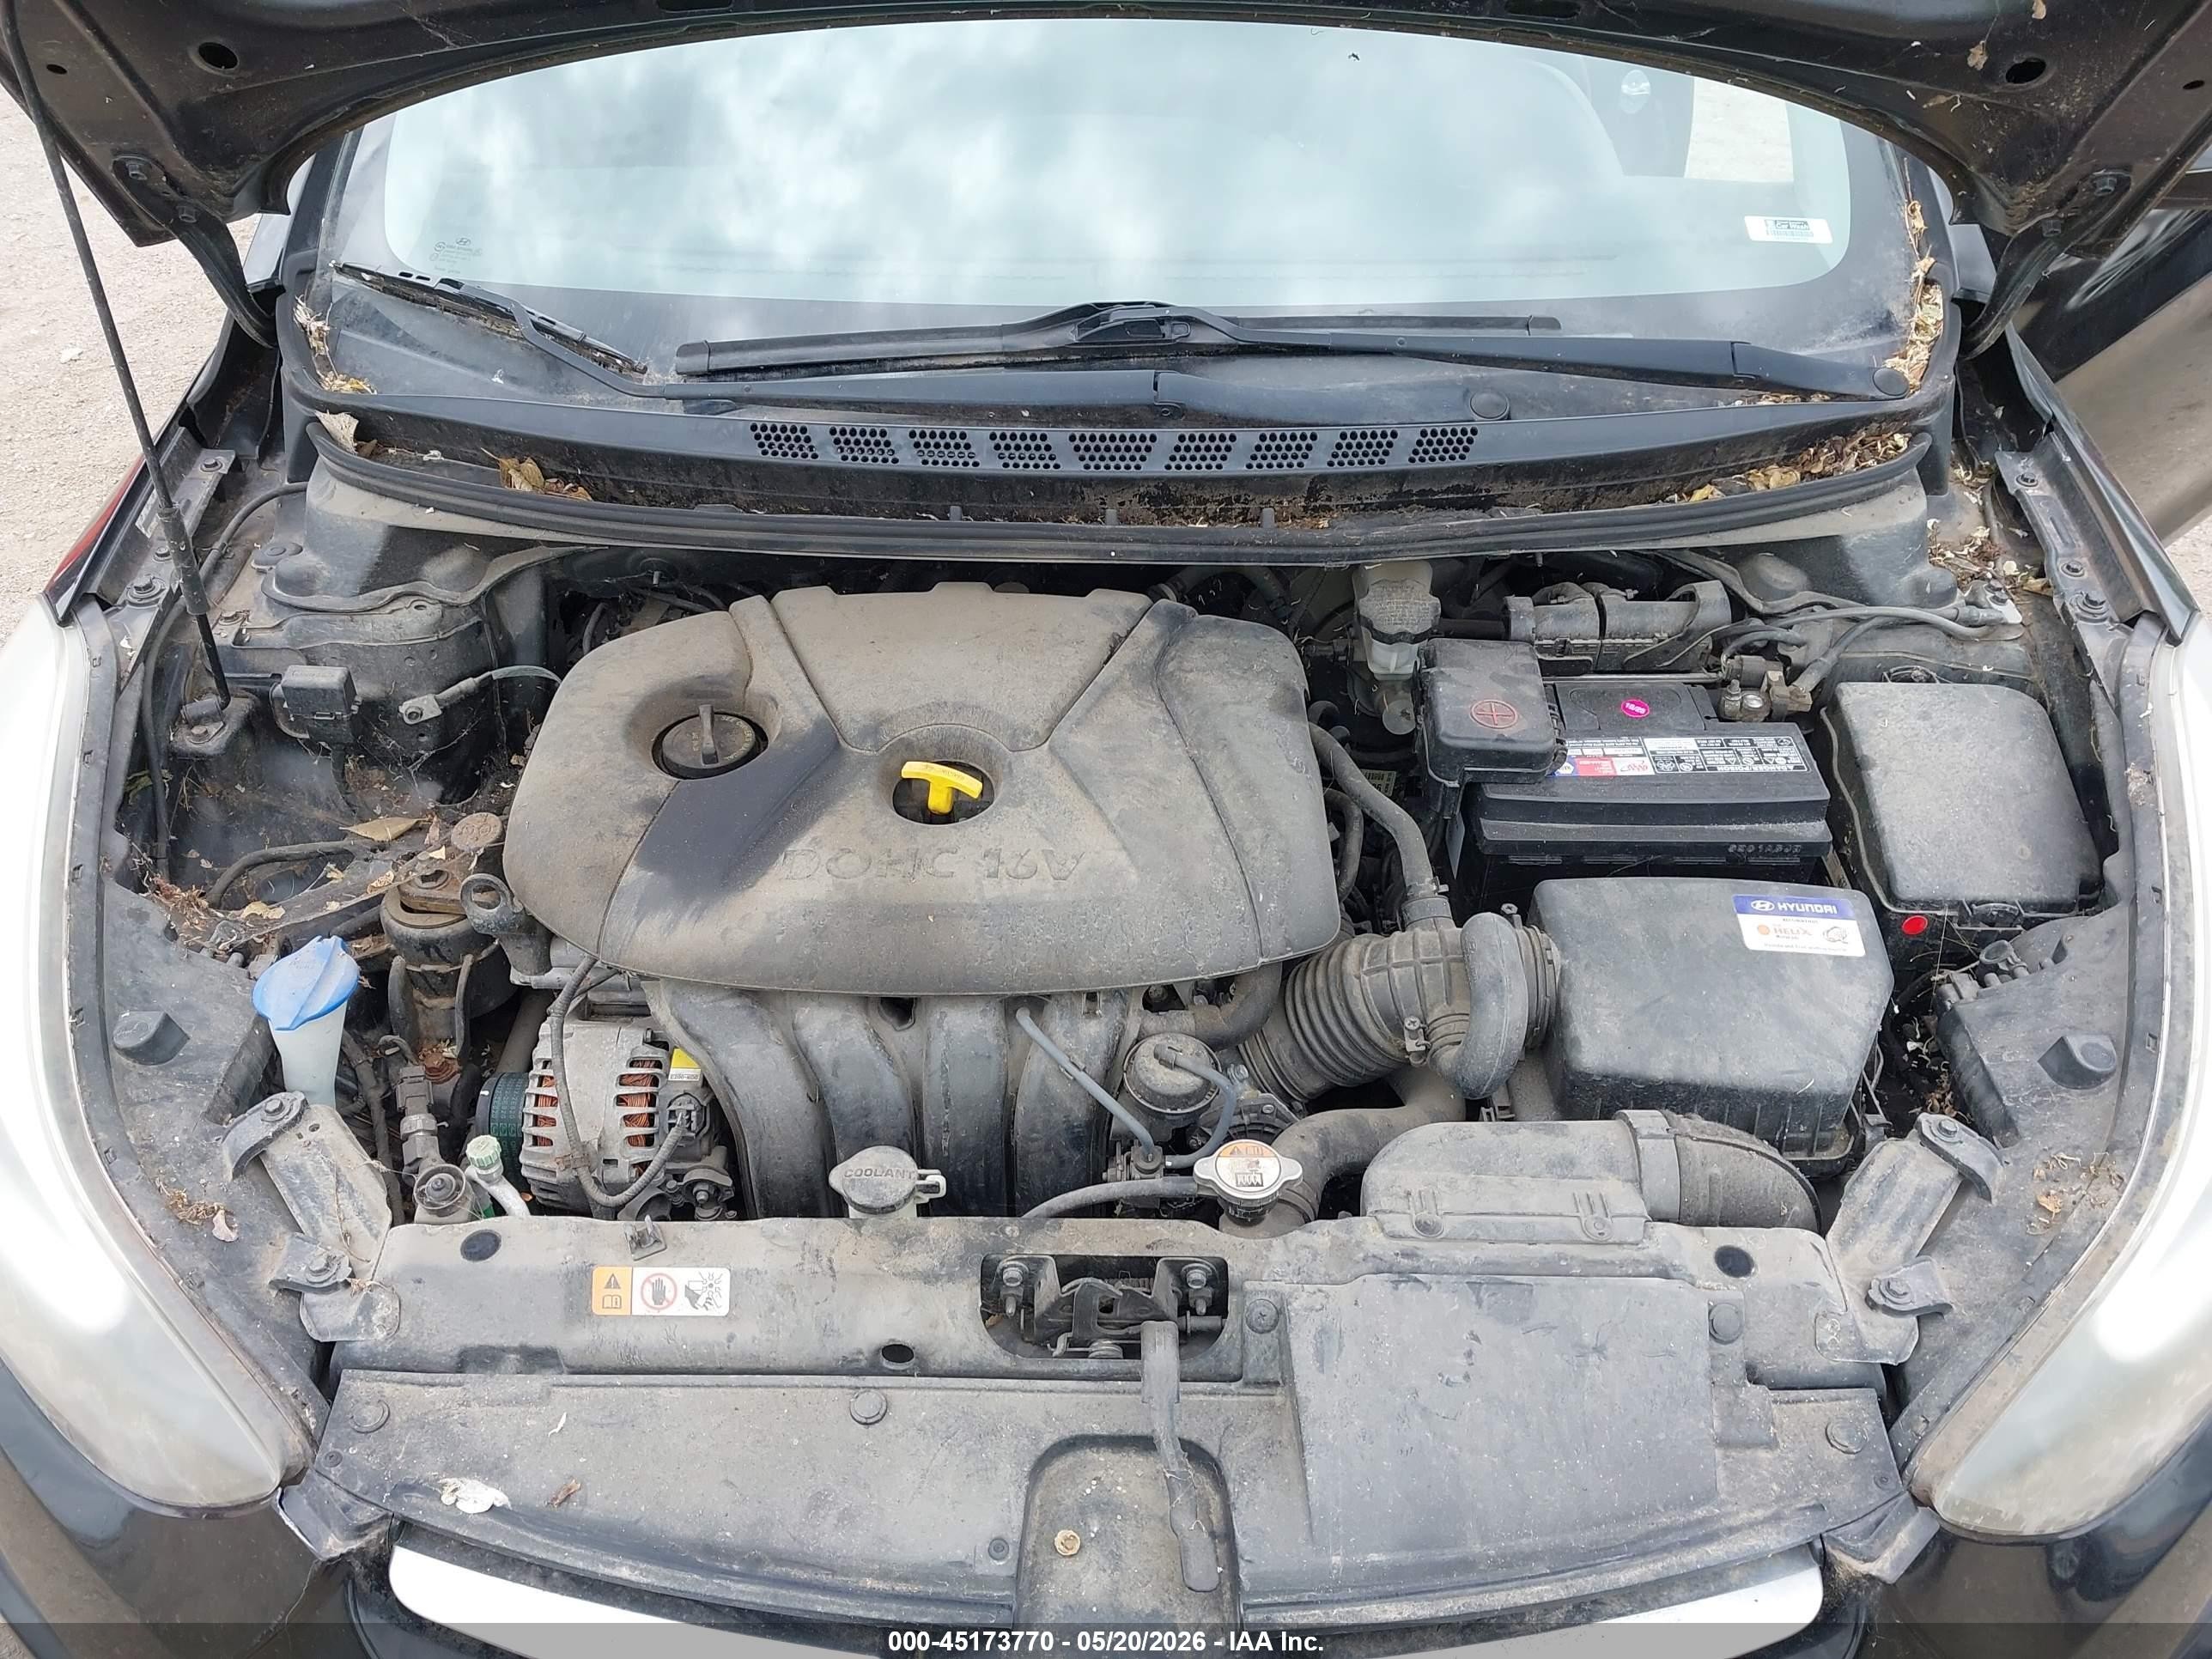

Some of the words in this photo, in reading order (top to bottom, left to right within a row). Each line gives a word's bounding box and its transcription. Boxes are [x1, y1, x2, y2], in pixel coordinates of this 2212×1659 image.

[781, 847, 958, 881] DOHC
[983, 847, 1085, 881] 16V
[1778, 902, 1838, 915] HYUNDAI
[844, 1168, 915, 1180] COOLANT
